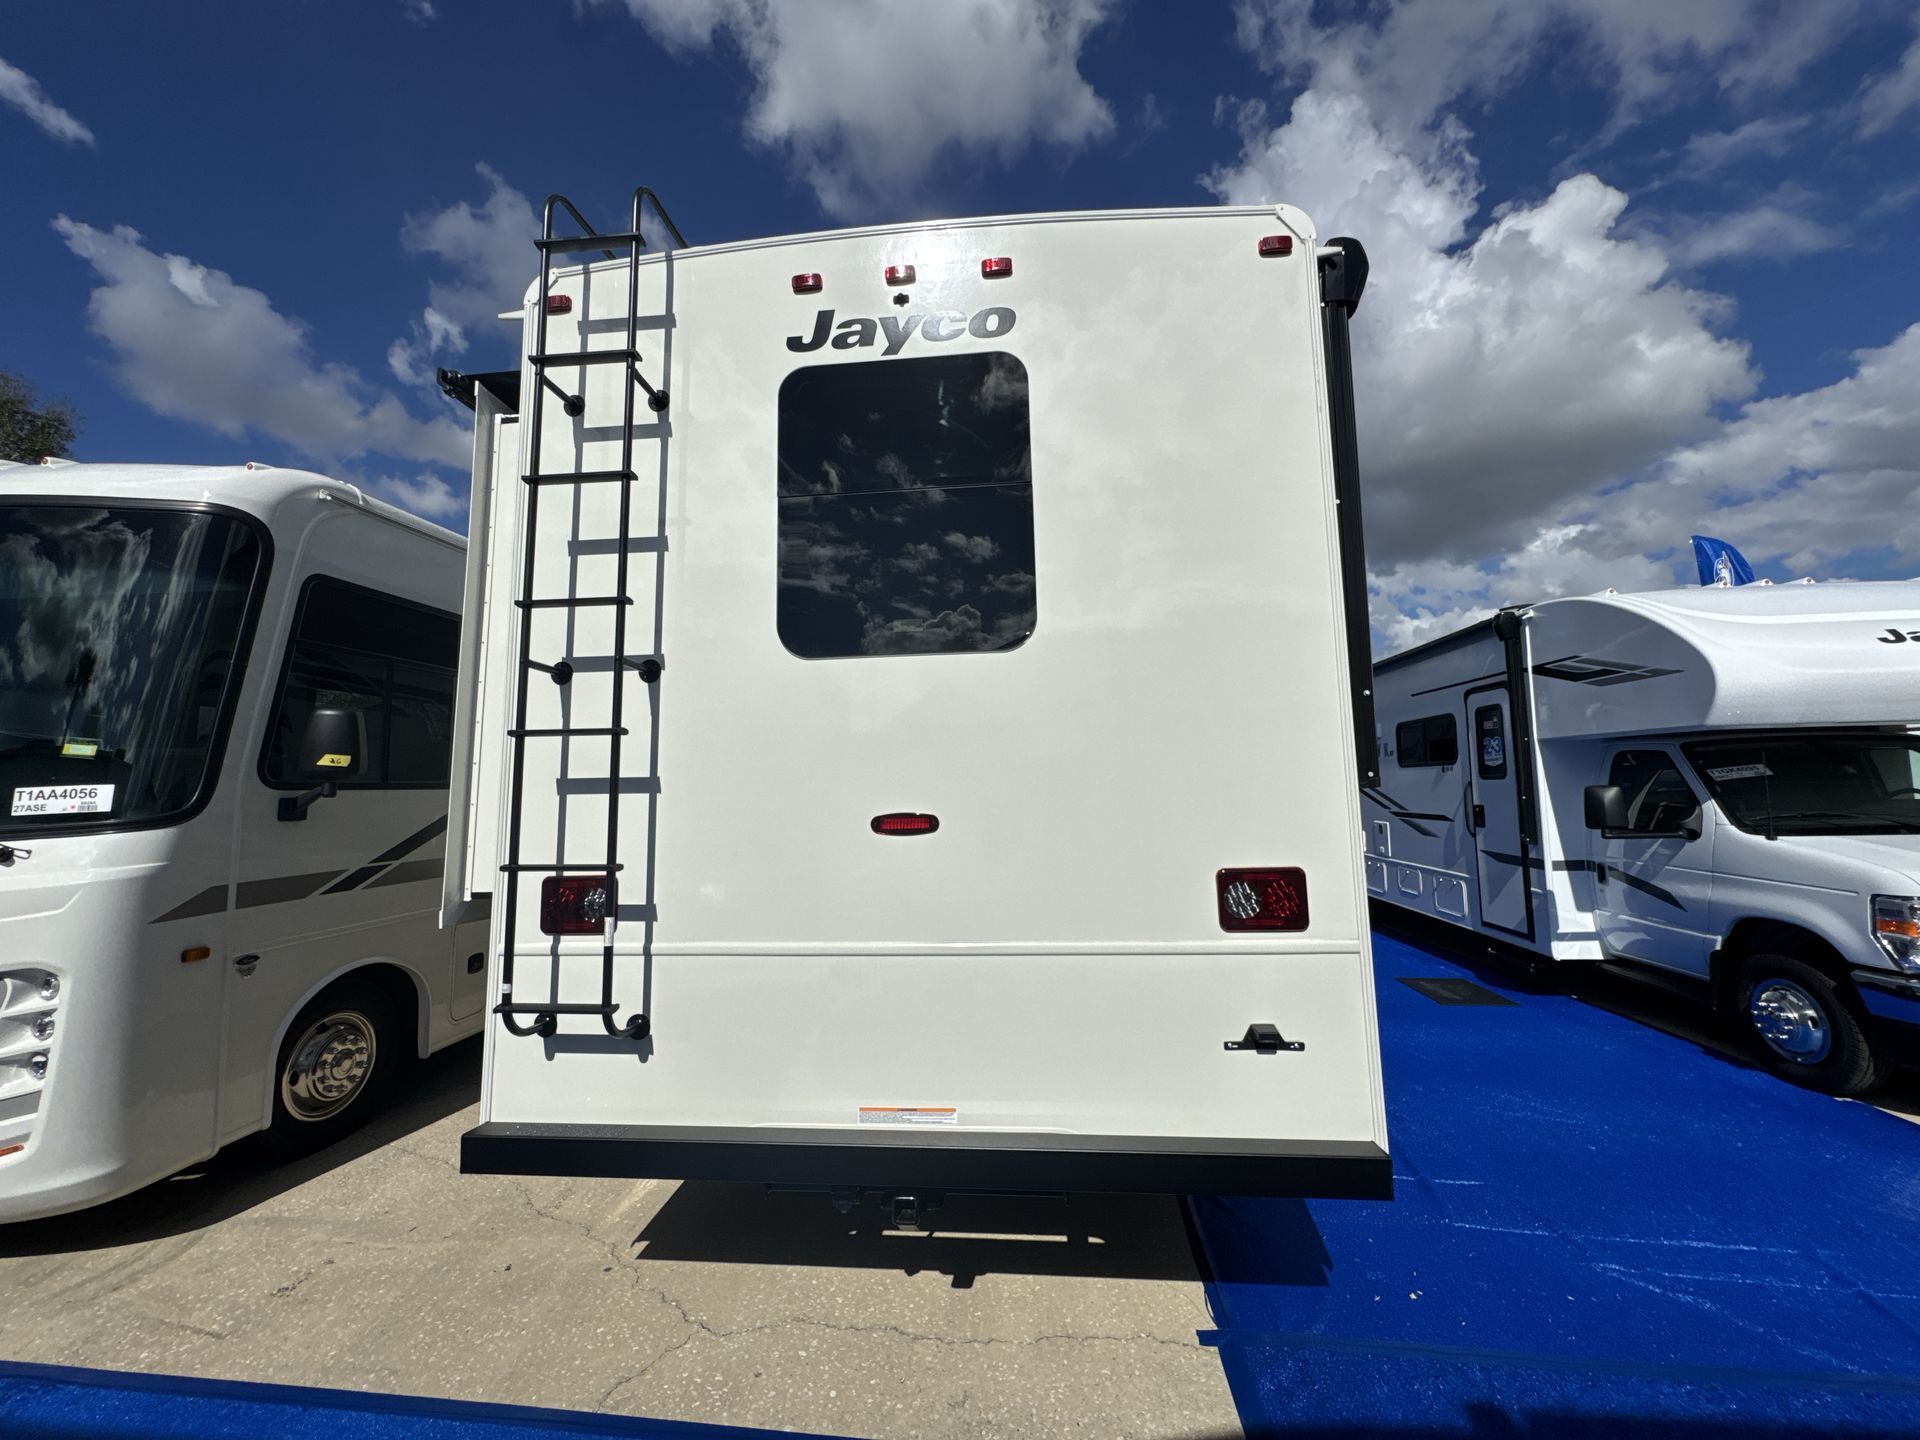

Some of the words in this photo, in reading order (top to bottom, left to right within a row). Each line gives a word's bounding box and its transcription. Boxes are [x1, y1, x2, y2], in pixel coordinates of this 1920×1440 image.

[786, 306, 1017, 356] Jayco
[16, 788, 98, 801] T1AA4056
[13, 803, 48, 813] 27ASE
